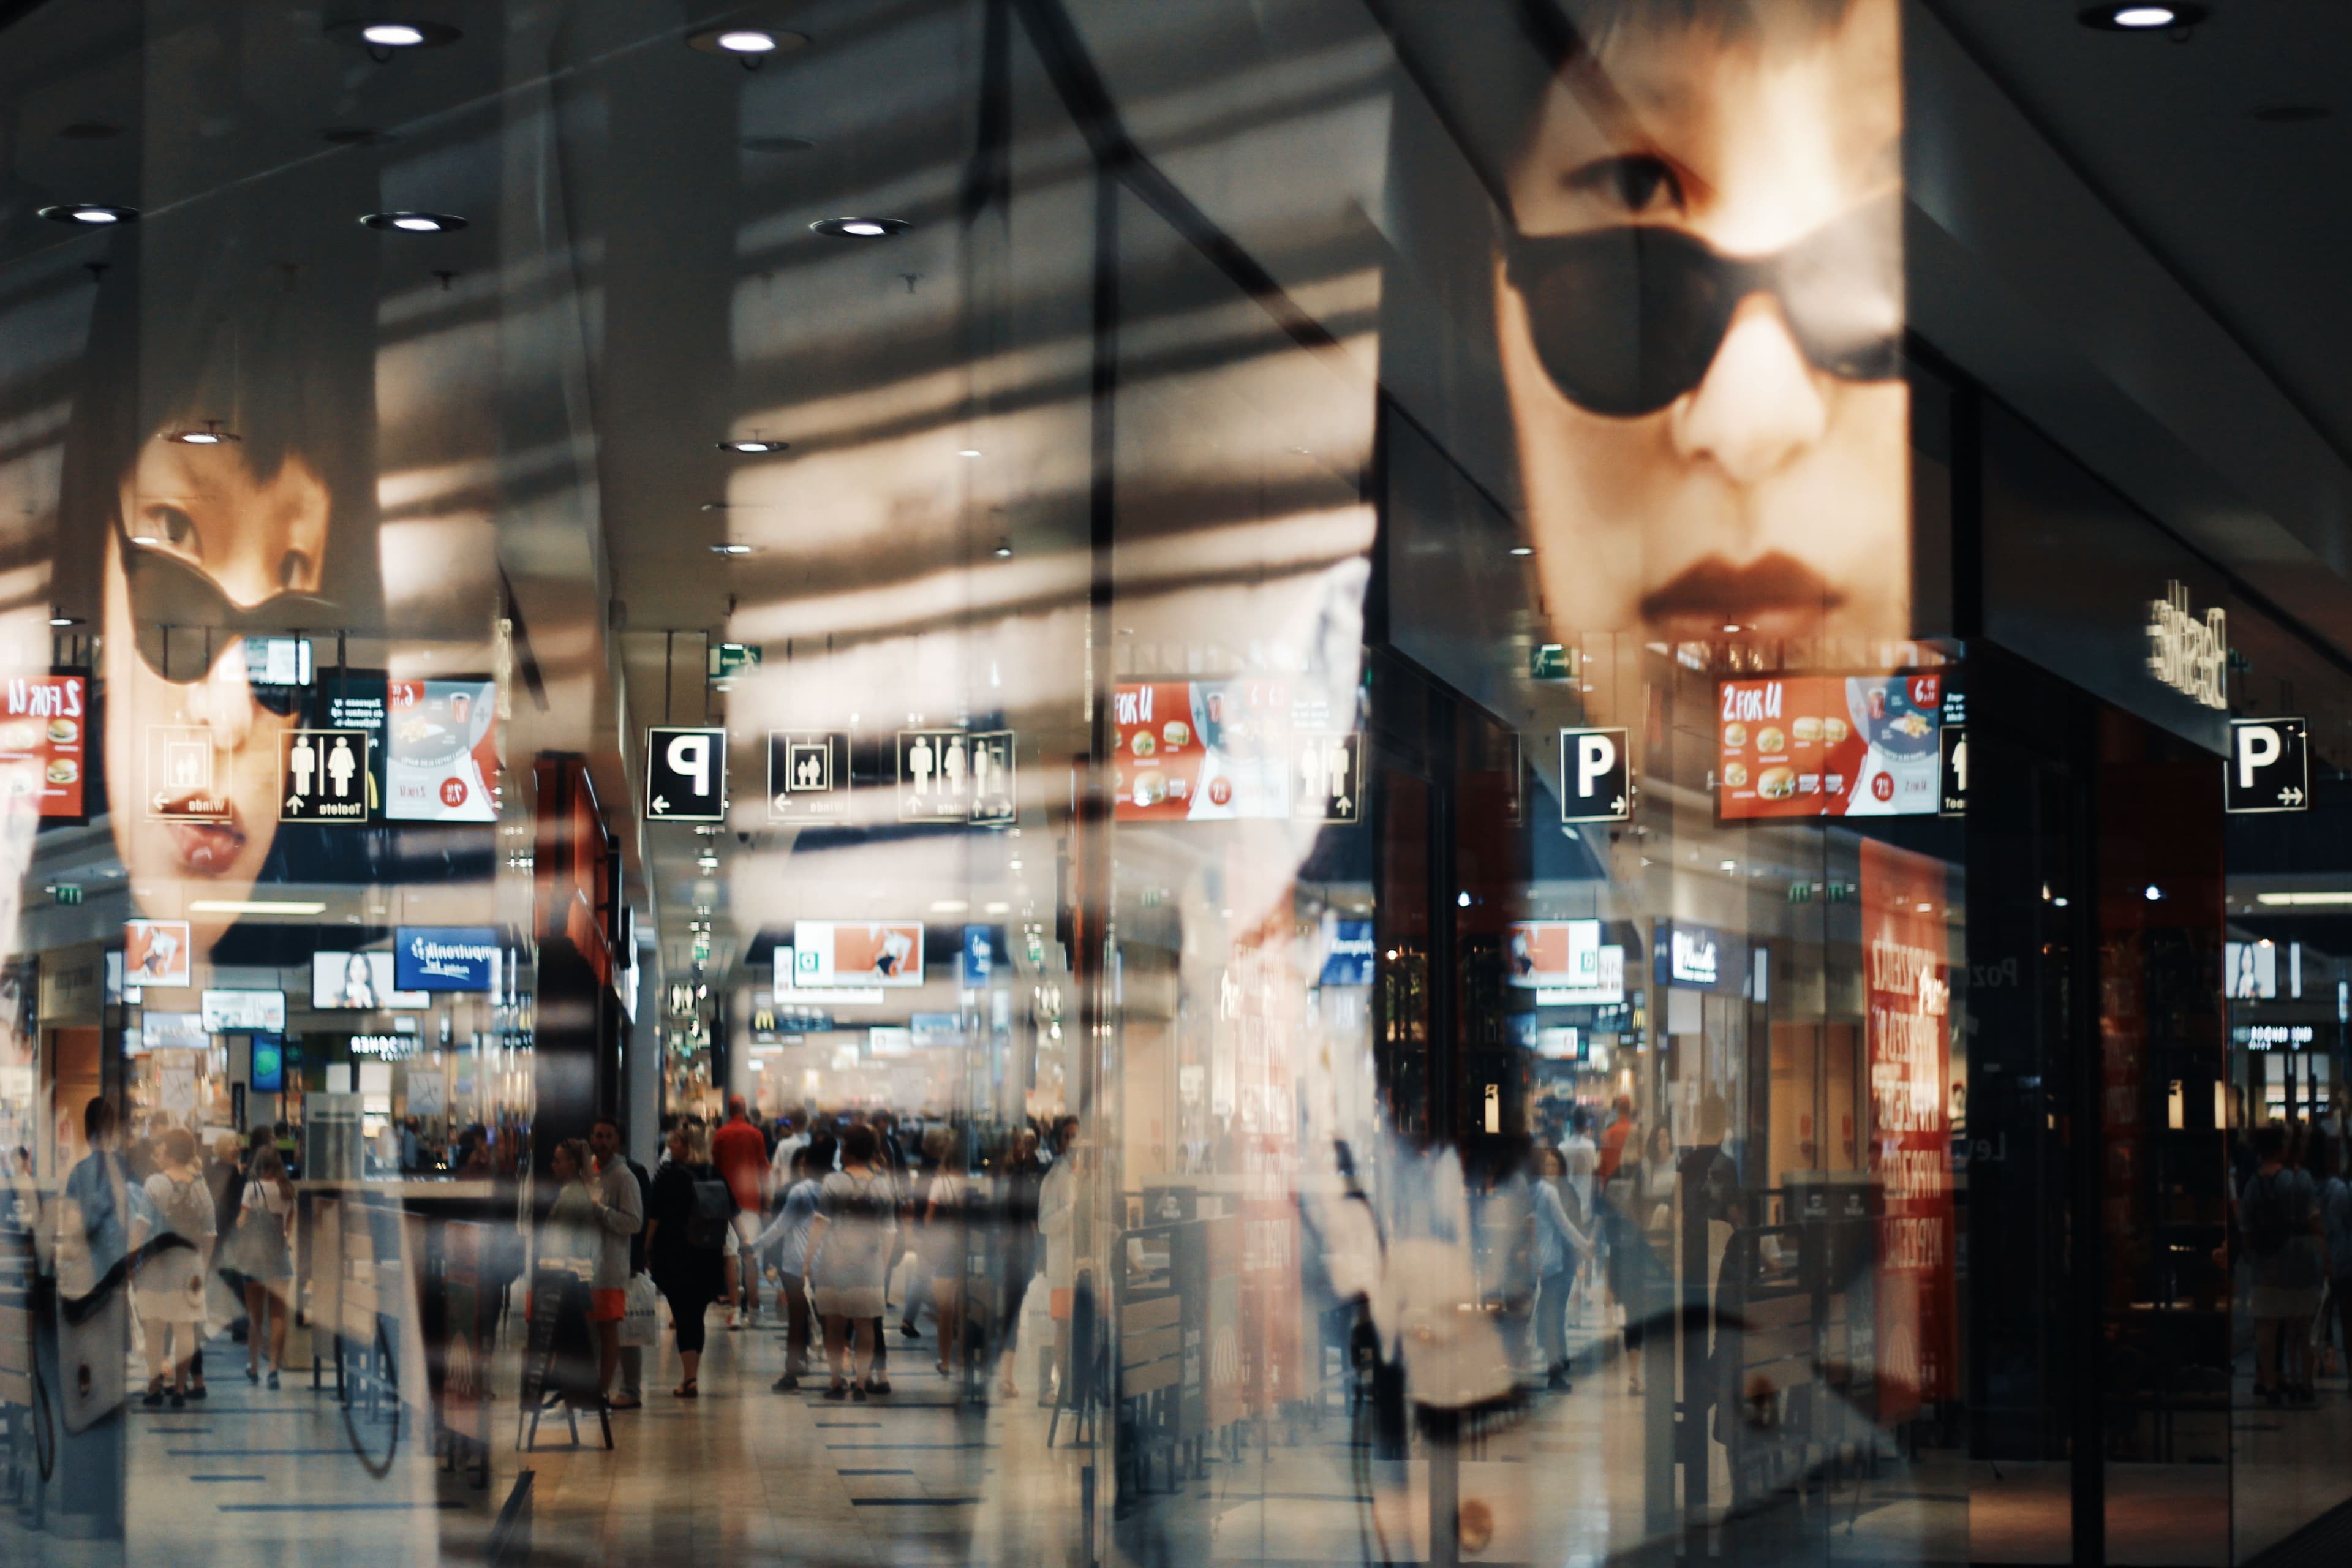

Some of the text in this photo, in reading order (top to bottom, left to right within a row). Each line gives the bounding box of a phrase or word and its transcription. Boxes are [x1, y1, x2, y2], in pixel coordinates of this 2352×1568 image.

[1139, 685, 1153, 723] U
[1723, 682, 1782, 721] 2 FOR U
[1578, 735, 1614, 797] P
[2239, 726, 2280, 788] P
